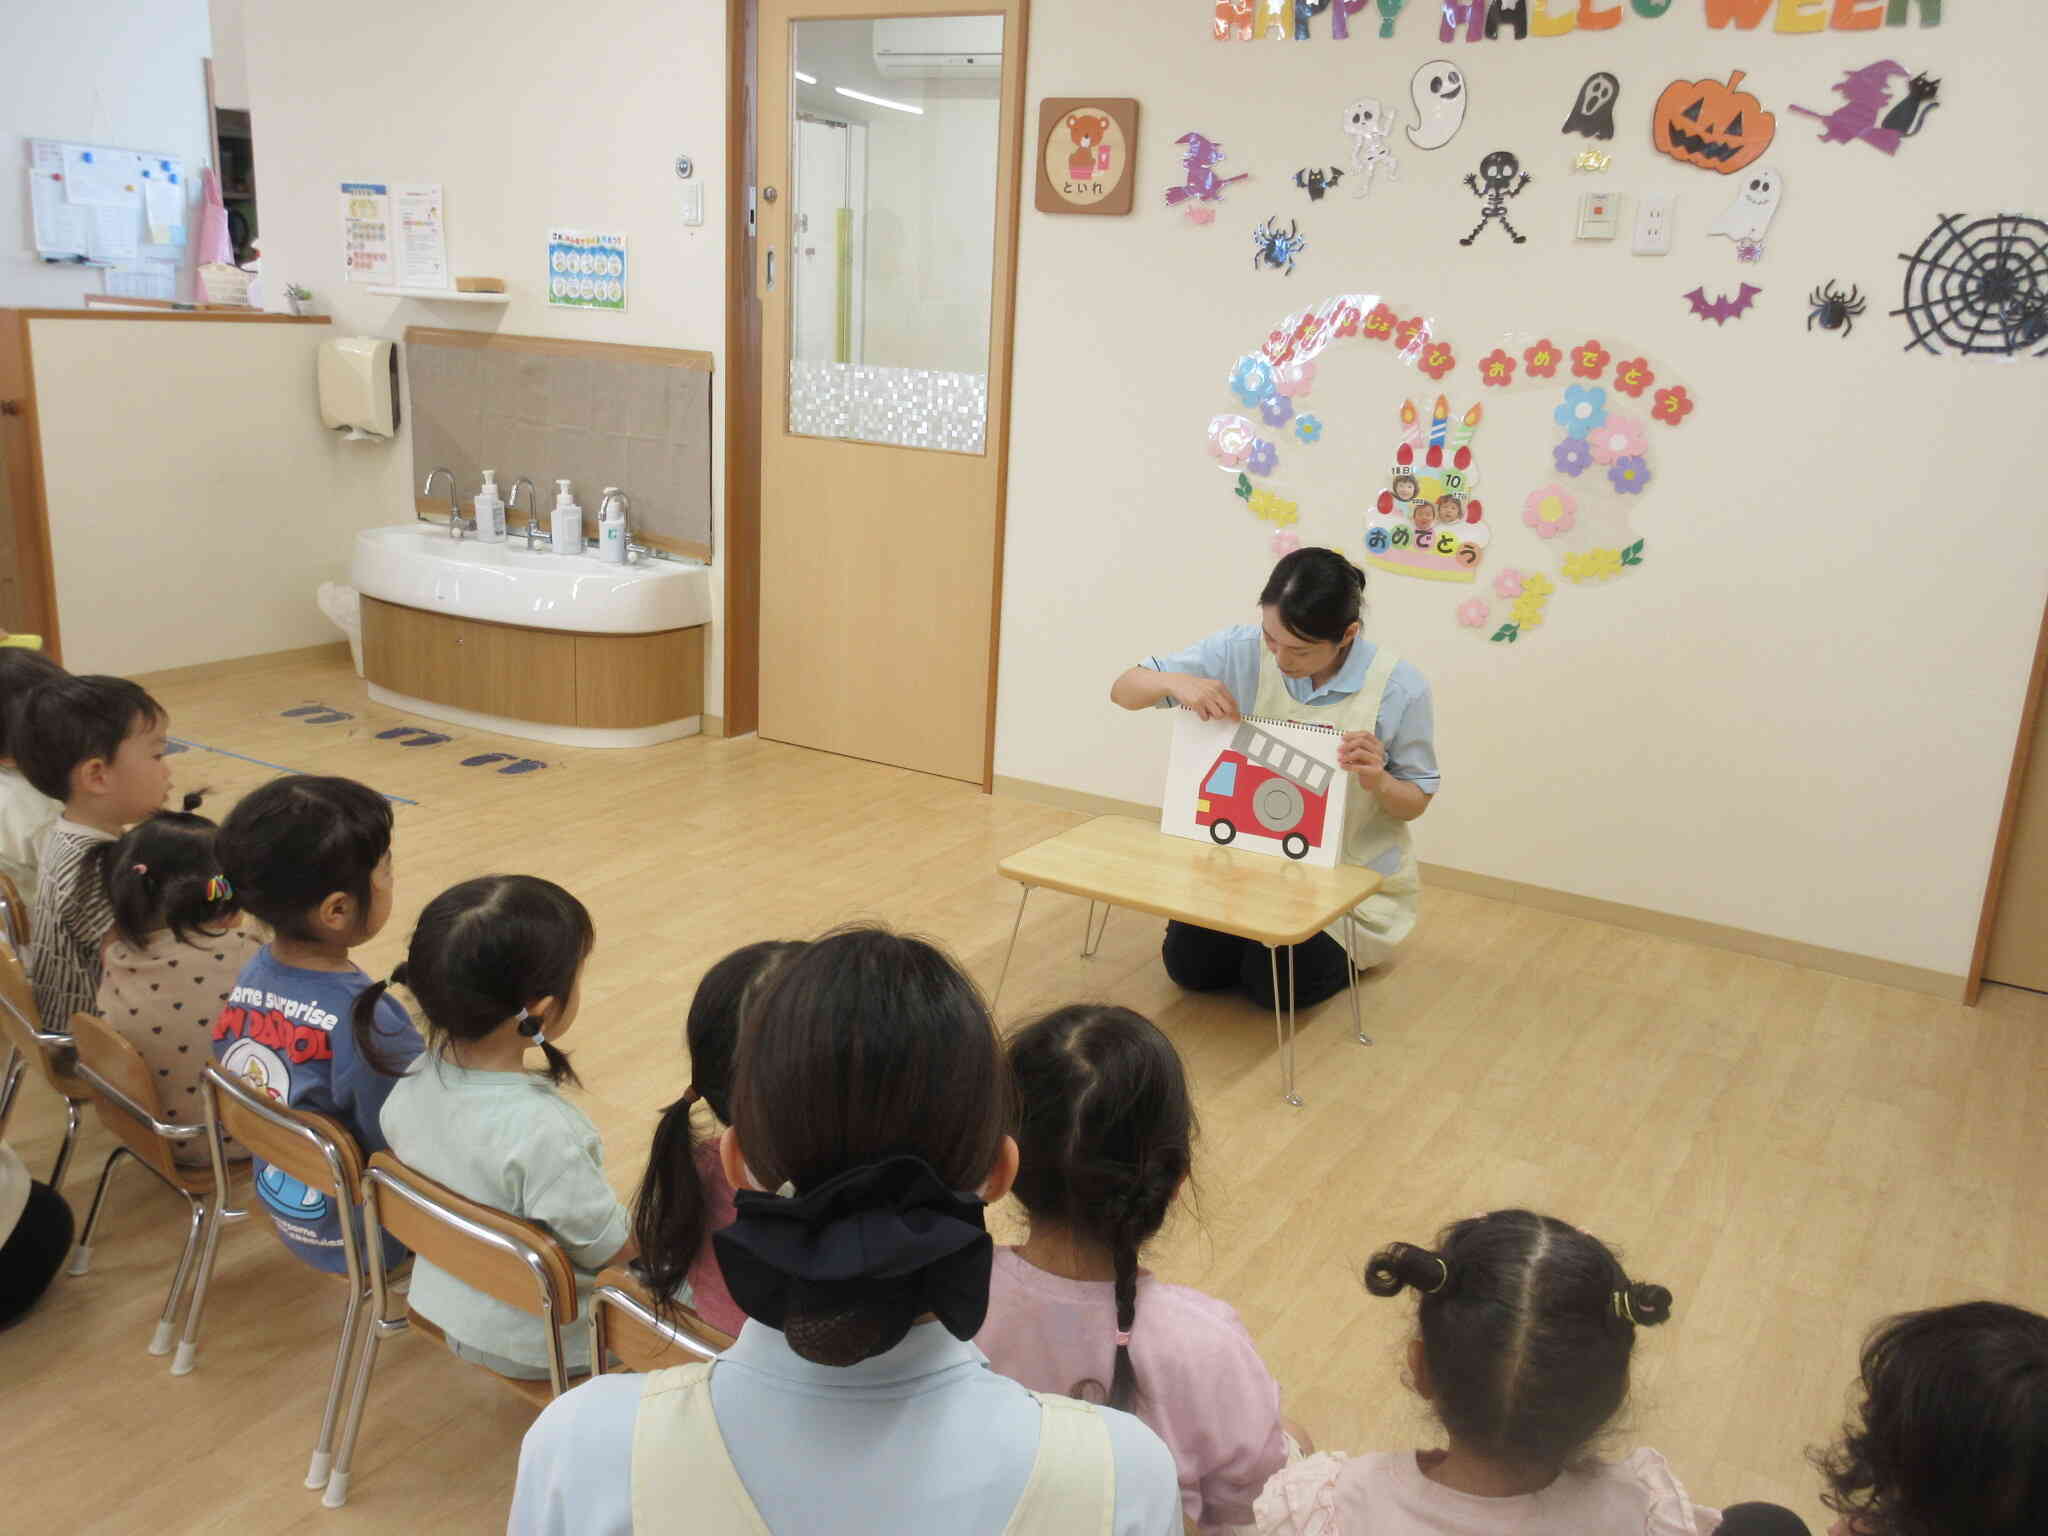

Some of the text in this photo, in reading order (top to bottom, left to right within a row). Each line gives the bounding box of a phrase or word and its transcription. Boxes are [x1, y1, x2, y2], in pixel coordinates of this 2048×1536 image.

[1063, 181, 1103, 195] といれ
[1488, 351, 1679, 413] おめでとう
[1445, 474, 1461, 489] 10
[1368, 526, 1477, 565] おめでとう
[265, 991, 339, 1032] surprise
